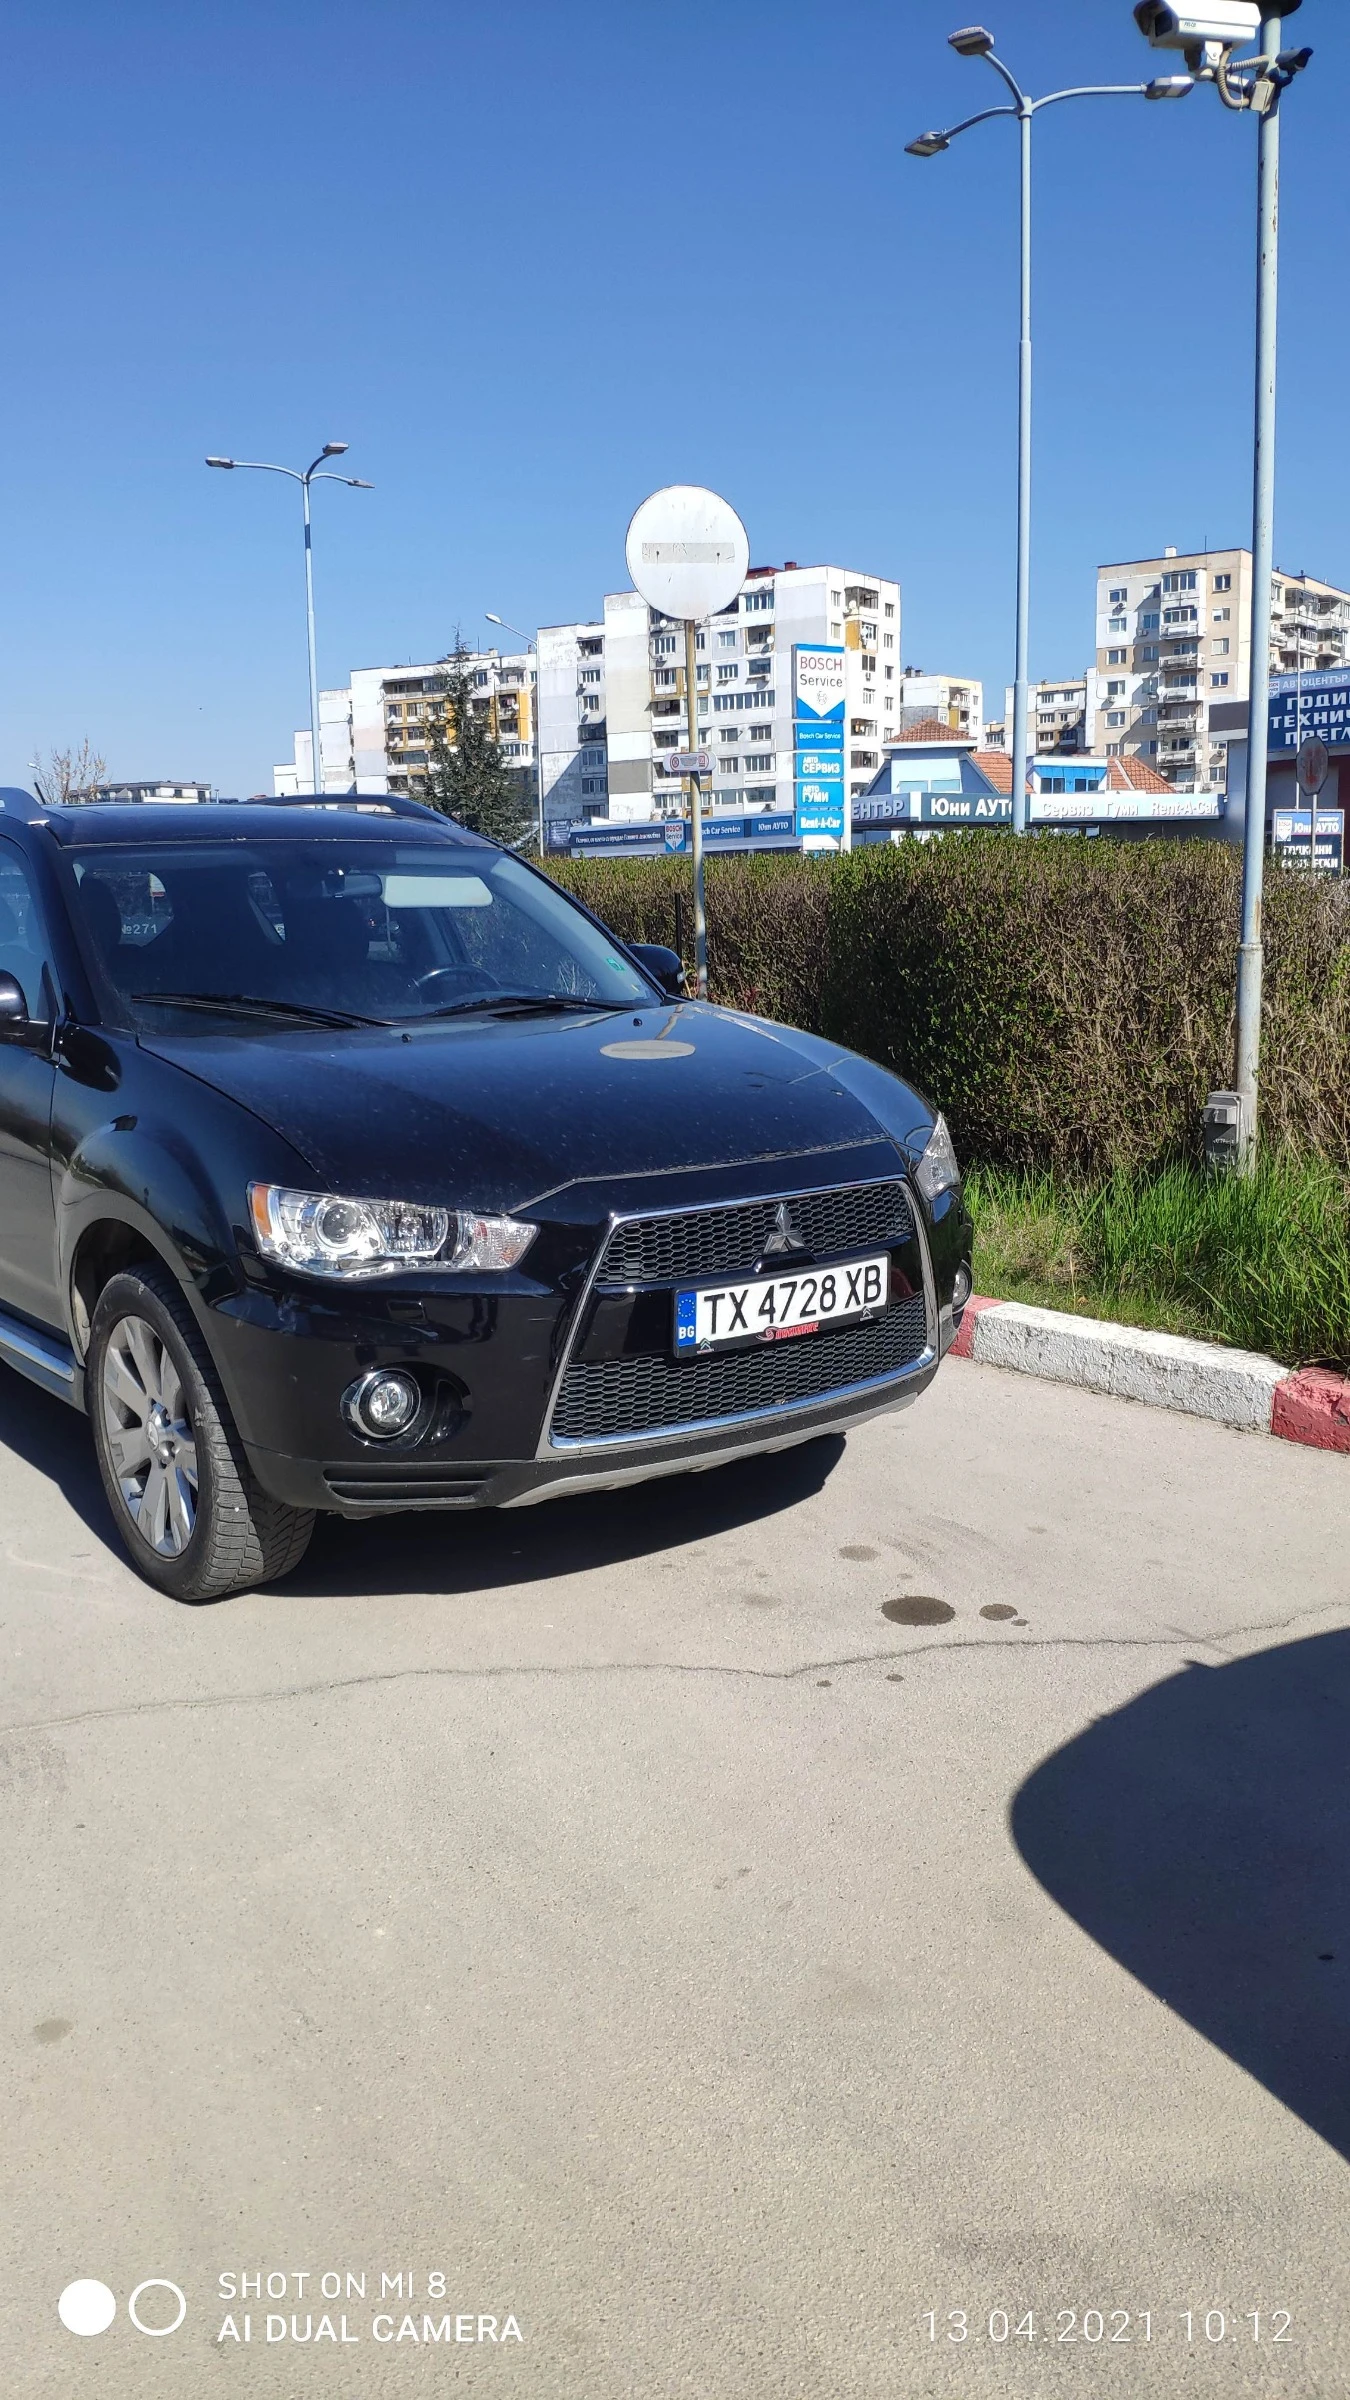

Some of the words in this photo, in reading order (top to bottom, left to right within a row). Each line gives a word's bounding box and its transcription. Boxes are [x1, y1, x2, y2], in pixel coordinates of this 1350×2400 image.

[800, 656, 842, 671] BOSCH
[799, 674, 843, 687] Service
[1286, 691, 1350, 711] ГОДИ
[802, 763, 840, 774] СЕРВИЗ
[802, 791, 829, 803] ГУМИ
[851, 799, 904, 820] ЕНТЪР
[931, 798, 970, 816] Юни
[1043, 803, 1094, 818] Сервиз
[1105, 803, 1139, 818] Гуми
[1152, 801, 1218, 816] Rent-A-Car
[773, 821, 788, 830] АУТО
[800, 816, 842, 829] Rent-A-Car
[711, 826, 720, 835] Car
[721, 825, 740, 834] Service
[704, 1290, 749, 1335] TX
[757, 1274, 836, 1325] 4728
[844, 1264, 881, 1309] XB
[678, 1325, 695, 1339] BG
